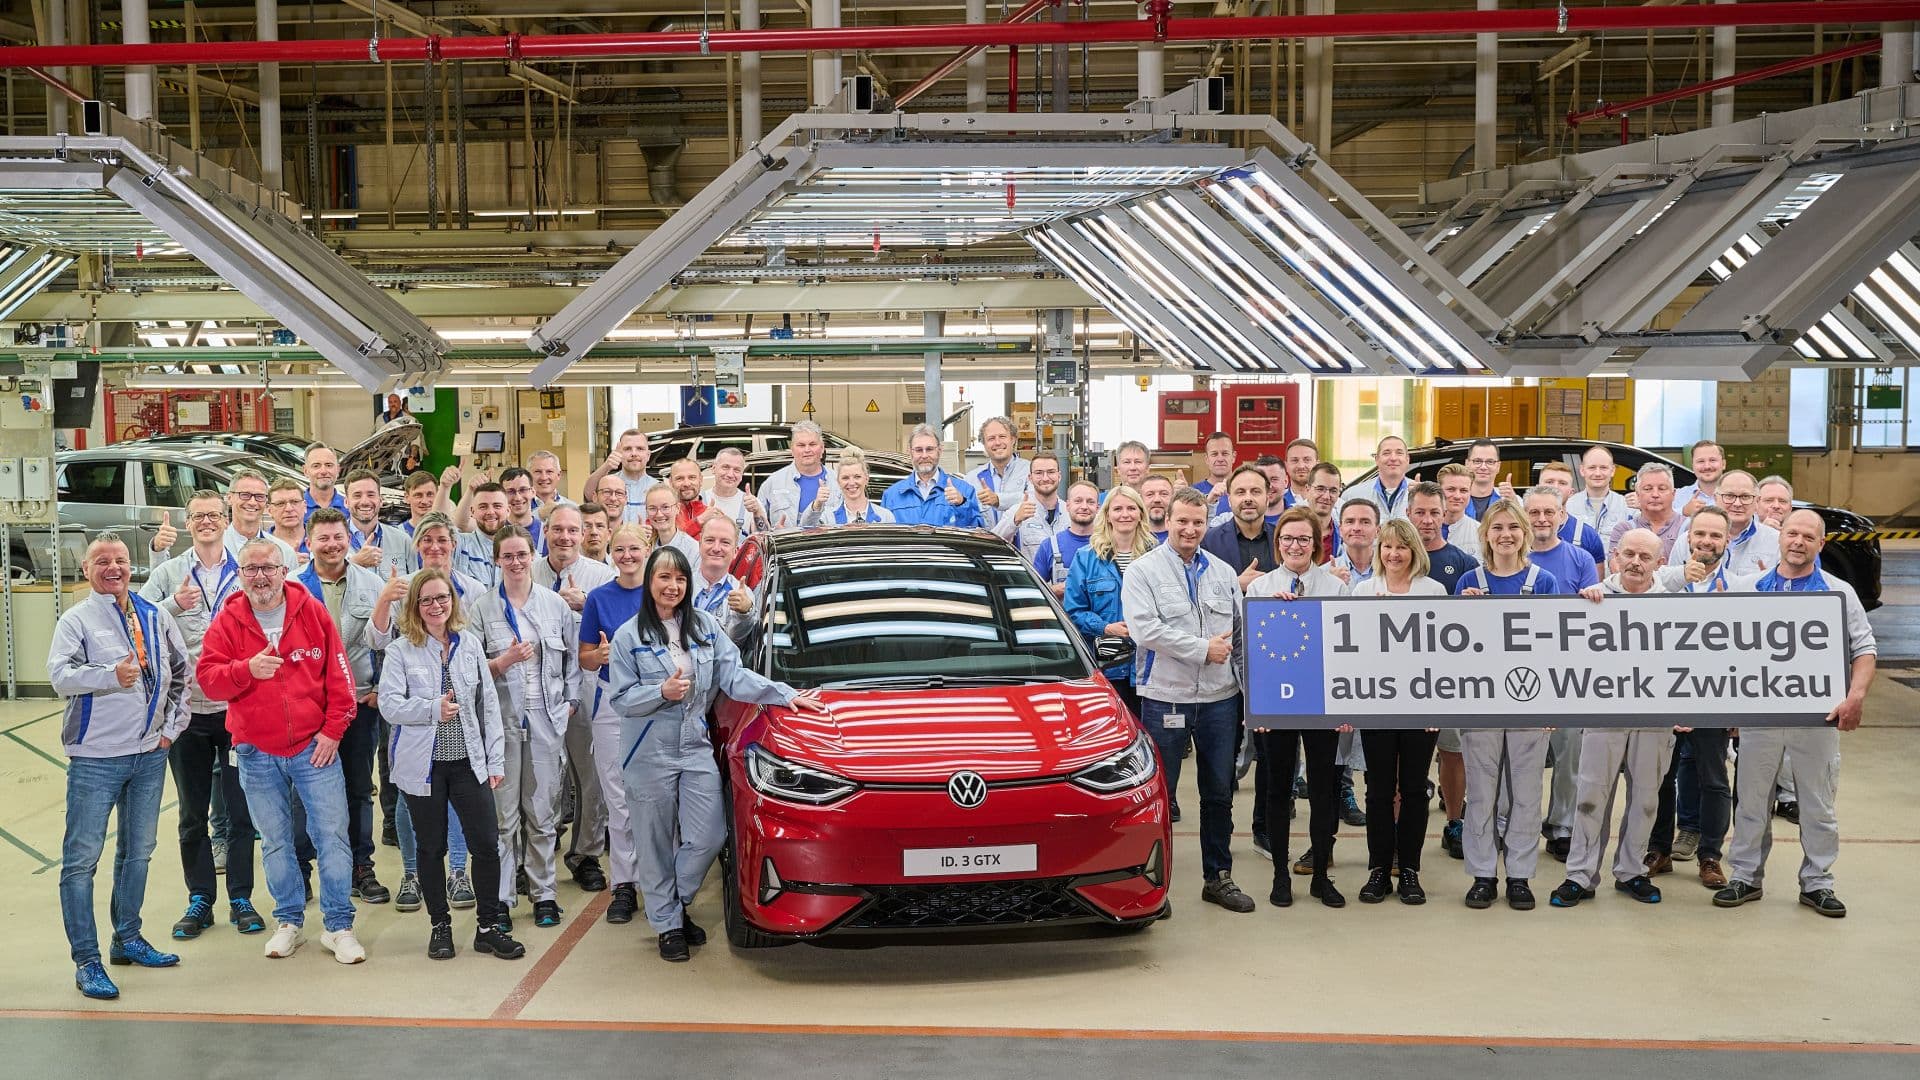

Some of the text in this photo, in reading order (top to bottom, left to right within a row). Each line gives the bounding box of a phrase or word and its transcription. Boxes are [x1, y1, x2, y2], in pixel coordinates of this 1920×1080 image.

[1333, 610, 1829, 662] 1 Mio. E-Fahrzeuge
[1280, 683, 1294, 699] D
[1331, 666, 1831, 702] aus dem VW Werk Zwickau
[948, 771, 987, 808] VW
[941, 853, 1001, 868] ID. 3 GTX
